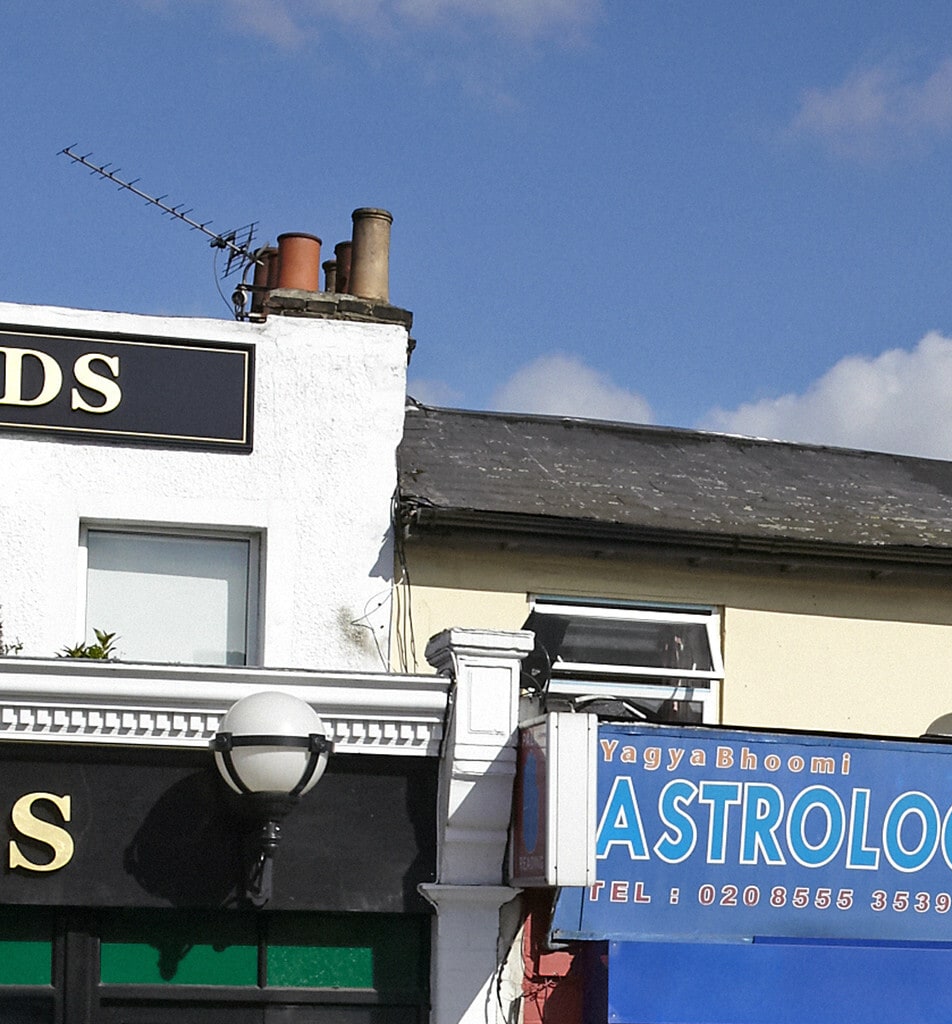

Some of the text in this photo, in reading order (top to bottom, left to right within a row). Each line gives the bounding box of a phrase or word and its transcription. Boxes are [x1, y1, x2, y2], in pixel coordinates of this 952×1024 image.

[600, 739, 851, 775] Yagya Bhoomi
[9, 791, 76, 872] S
[699, 884, 761, 907] 020
[770, 886, 854, 911] 8555
[870, 889, 952, 914] 3539
